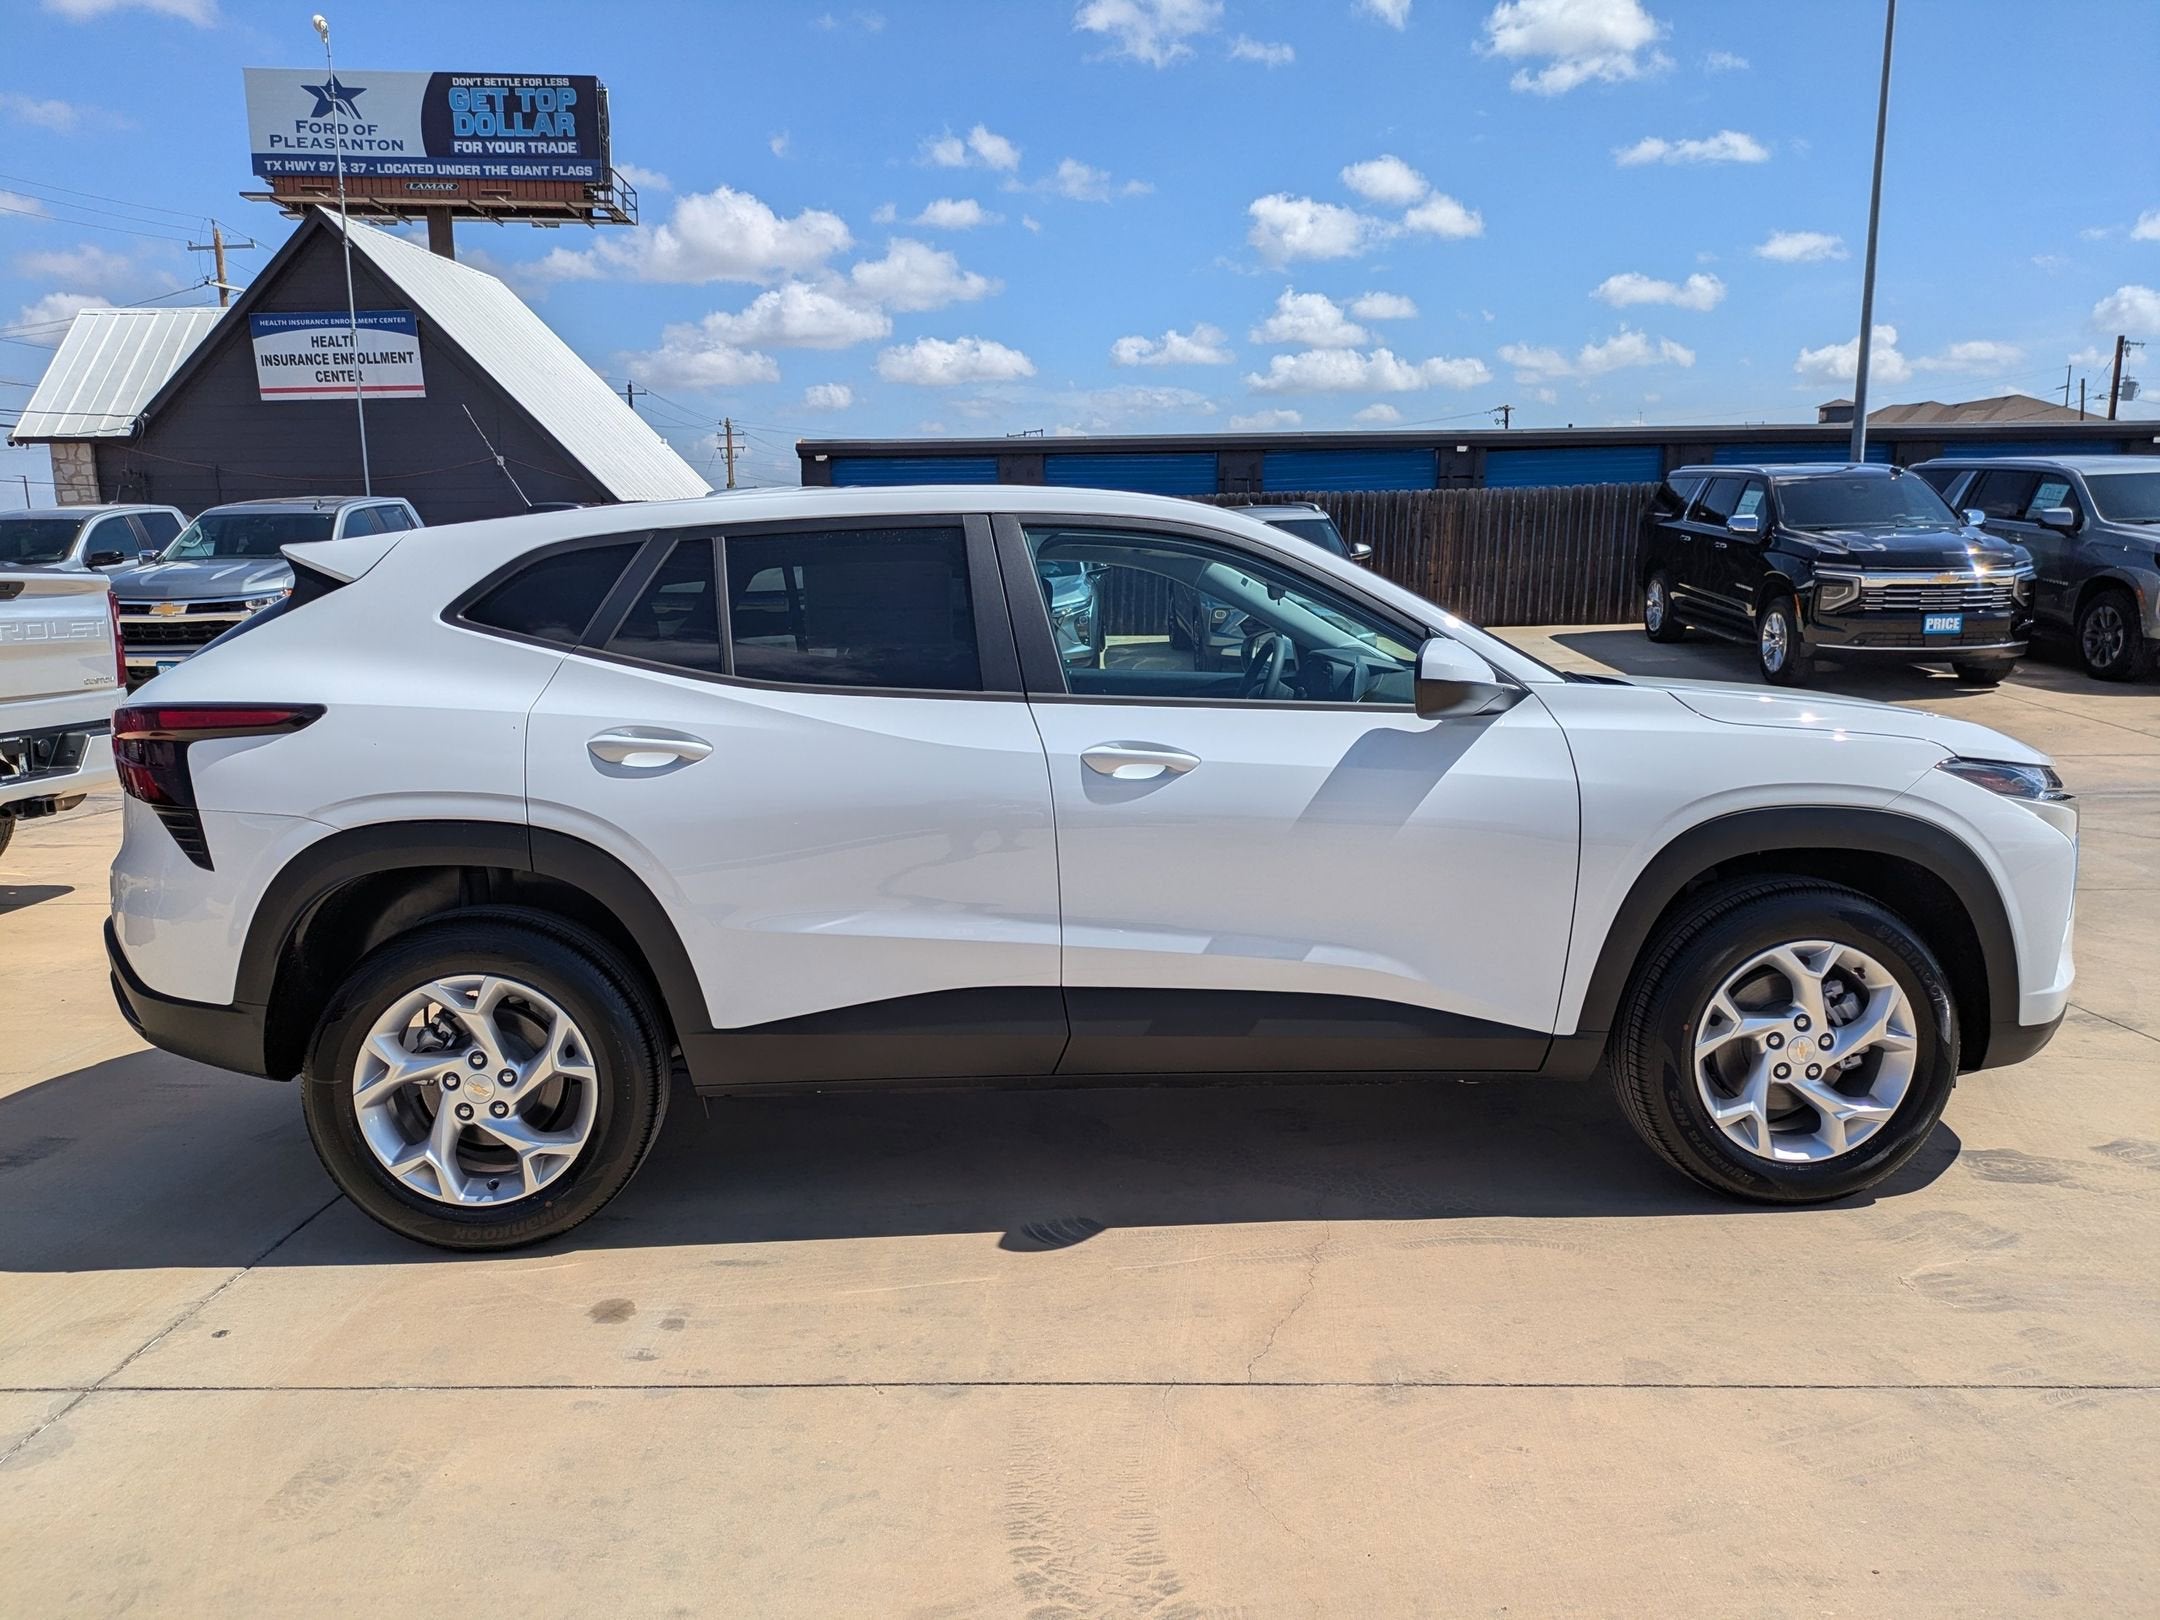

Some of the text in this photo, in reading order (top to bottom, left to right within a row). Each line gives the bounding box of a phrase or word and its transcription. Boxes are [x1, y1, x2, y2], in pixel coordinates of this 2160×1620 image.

[452, 77, 570, 87] DON'T SETTLE FOR LESS
[448, 87, 577, 112] GET TOP
[295, 119, 379, 136] FORD OF
[452, 111, 577, 137] DOLLAR
[269, 134, 404, 151] PLEASANTON
[453, 141, 578, 154] FOR YOUR TRADE
[264, 160, 282, 171] TX
[285, 160, 317, 172] HWY
[319, 161, 336, 172] 97
[340, 162, 348, 173] &
[350, 163, 367, 174] 37
[377, 163, 434, 175] LOCATED
[437, 164, 480, 176] UNDER
[483, 165, 509, 176] THE
[511, 165, 550, 177] GIANT
[552, 165, 593, 177] FLAGS
[409, 183, 454, 191] LAMAR
[259, 319, 287, 327] HEALTH
[288, 318, 329, 326] INSURANCE
[379, 316, 406, 324] CENTER
[260, 352, 330, 367] INSURANCE
[1925, 617, 1961, 631] PRICE
